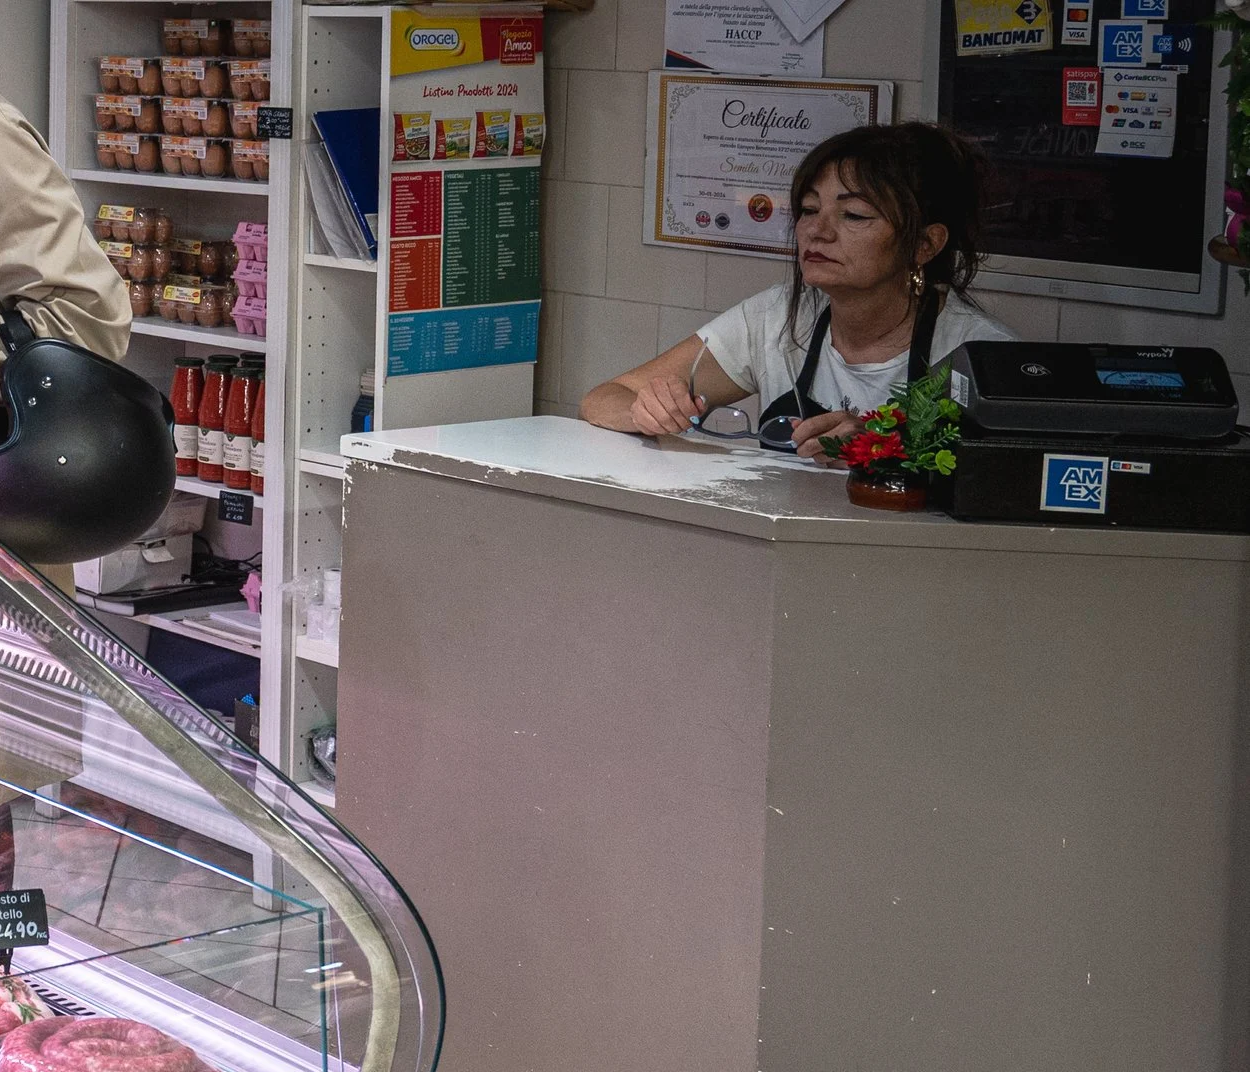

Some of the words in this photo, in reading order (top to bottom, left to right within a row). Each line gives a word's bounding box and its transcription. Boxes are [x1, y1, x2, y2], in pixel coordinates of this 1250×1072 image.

[725, 29, 762, 40] HACCP
[961, 29, 1046, 48] BANCOMAT
[1068, 31, 1085, 39] VISA
[1113, 31, 1143, 45] AM
[1116, 44, 1143, 57] EX
[1066, 70, 1098, 80] satispay
[423, 86, 454, 98] Listino
[457, 85, 494, 97] Prodotti
[496, 83, 518, 96] 2024
[721, 99, 810, 138] Certificato
[1060, 467, 1103, 484] AM
[1064, 484, 1102, 503] EX
[20, 894, 30, 903] di
